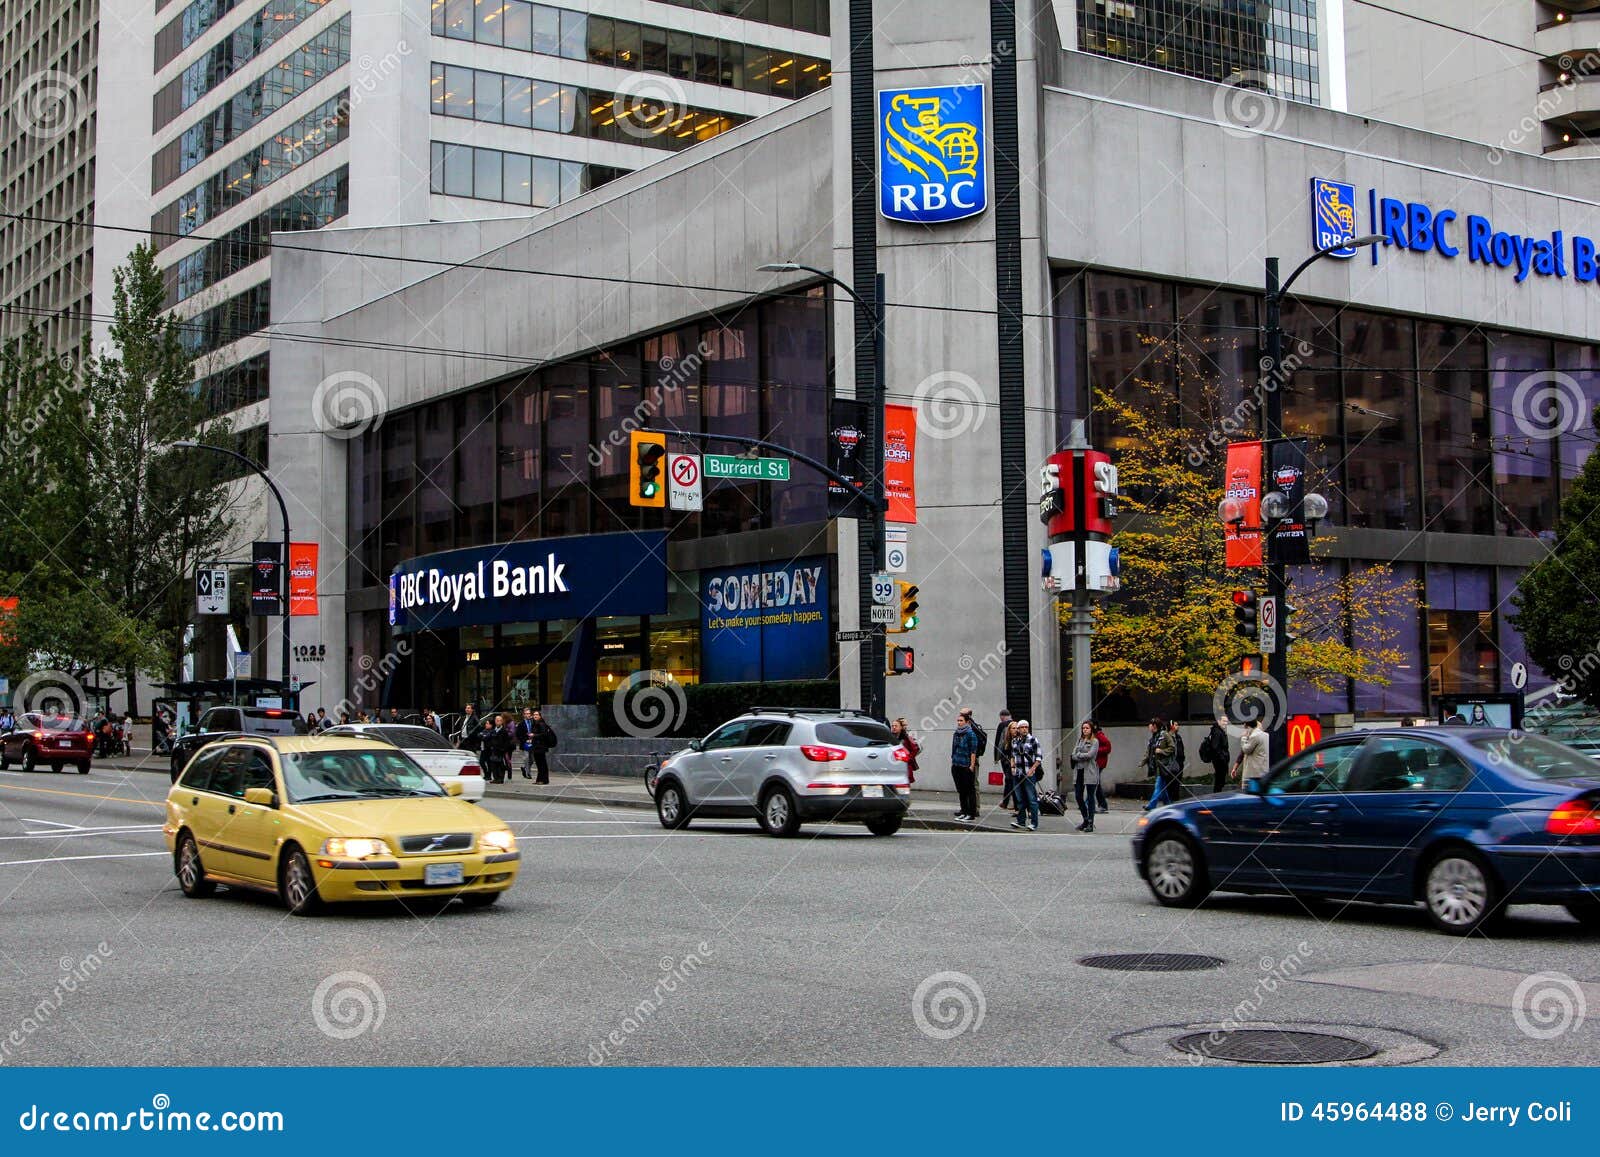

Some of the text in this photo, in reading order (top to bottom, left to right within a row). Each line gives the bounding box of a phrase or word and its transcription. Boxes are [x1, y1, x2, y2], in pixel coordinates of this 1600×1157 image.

[891, 181, 976, 212] RBC
[1381, 197, 1460, 258] RBC
[1467, 214, 1567, 283] Royal
[710, 459, 784, 476] Burrard St
[400, 552, 570, 612] RBC Royal Bank
[708, 567, 822, 611] SOMEDAY
[874, 583, 892, 597] 99
[708, 610, 823, 629] Let's make your someday happen.
[872, 608, 894, 620] NORTH
[293, 644, 326, 656] 1025
